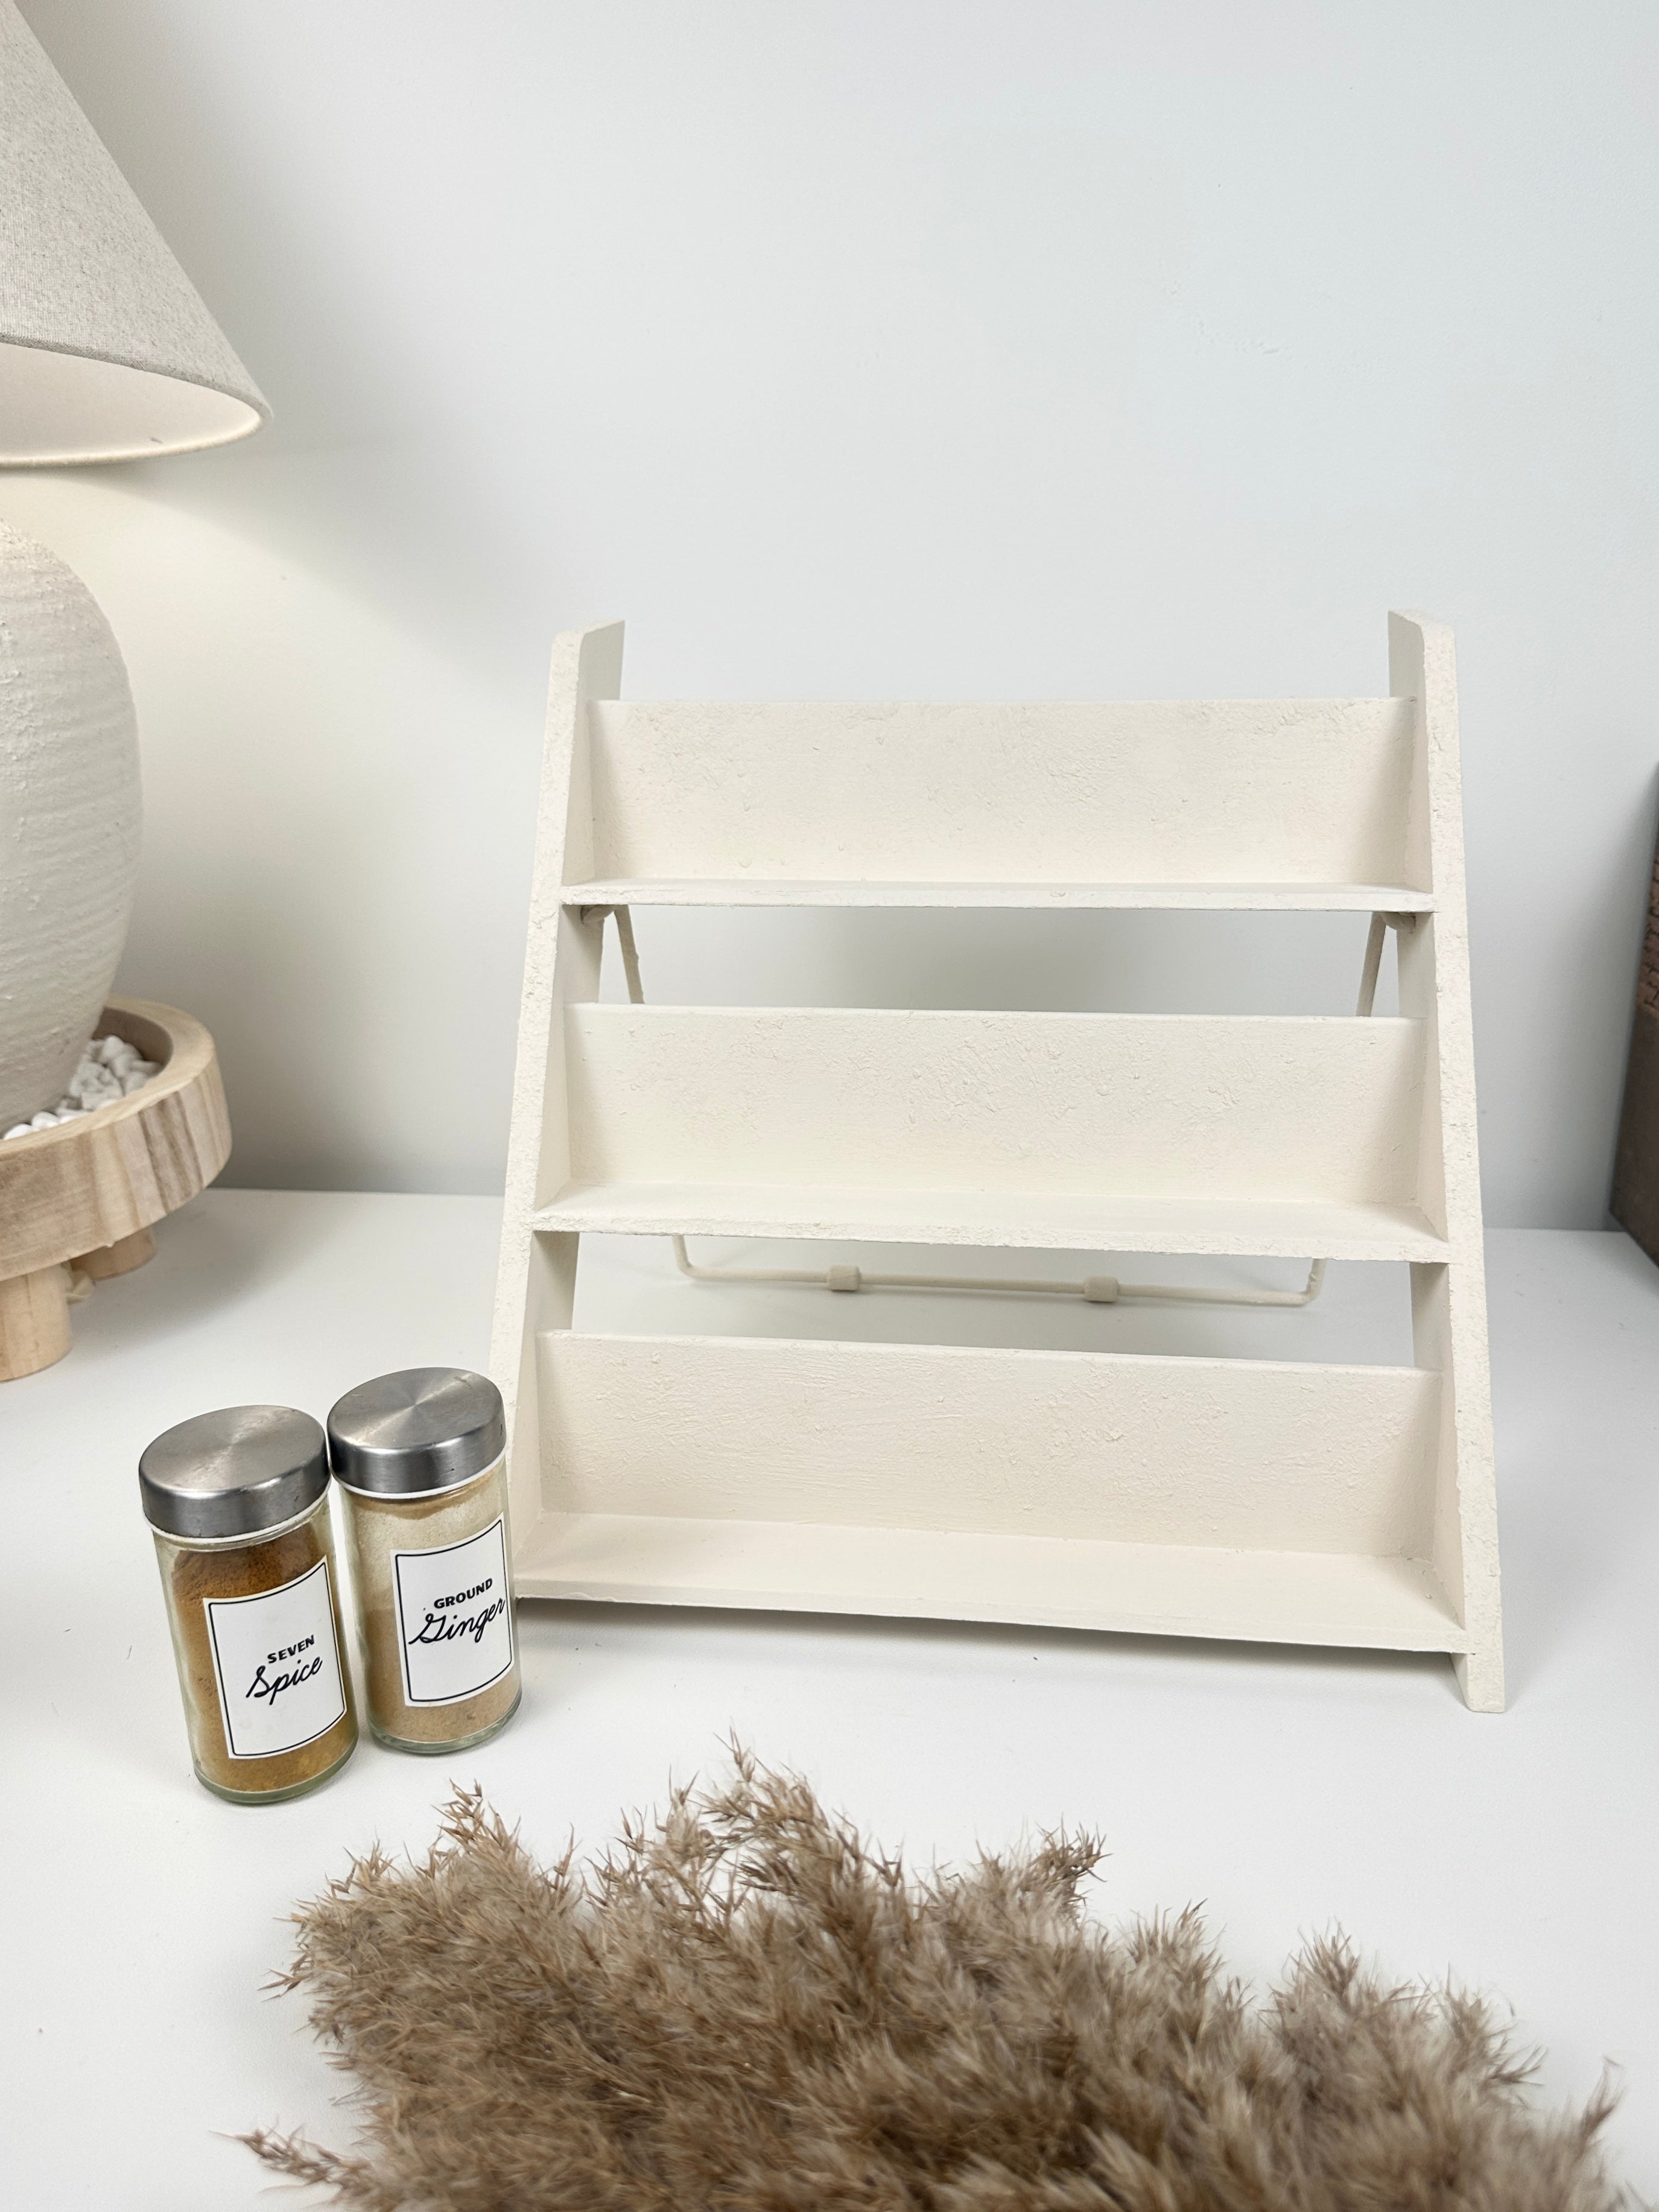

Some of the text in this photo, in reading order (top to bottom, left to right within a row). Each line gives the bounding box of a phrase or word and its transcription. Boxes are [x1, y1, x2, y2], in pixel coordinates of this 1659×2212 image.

[434, 1578, 493, 1609] GROUND
[408, 1598, 506, 1644] Ginger
[267, 1634, 316, 1664] SEVEN
[246, 1656, 323, 1705] Spice
